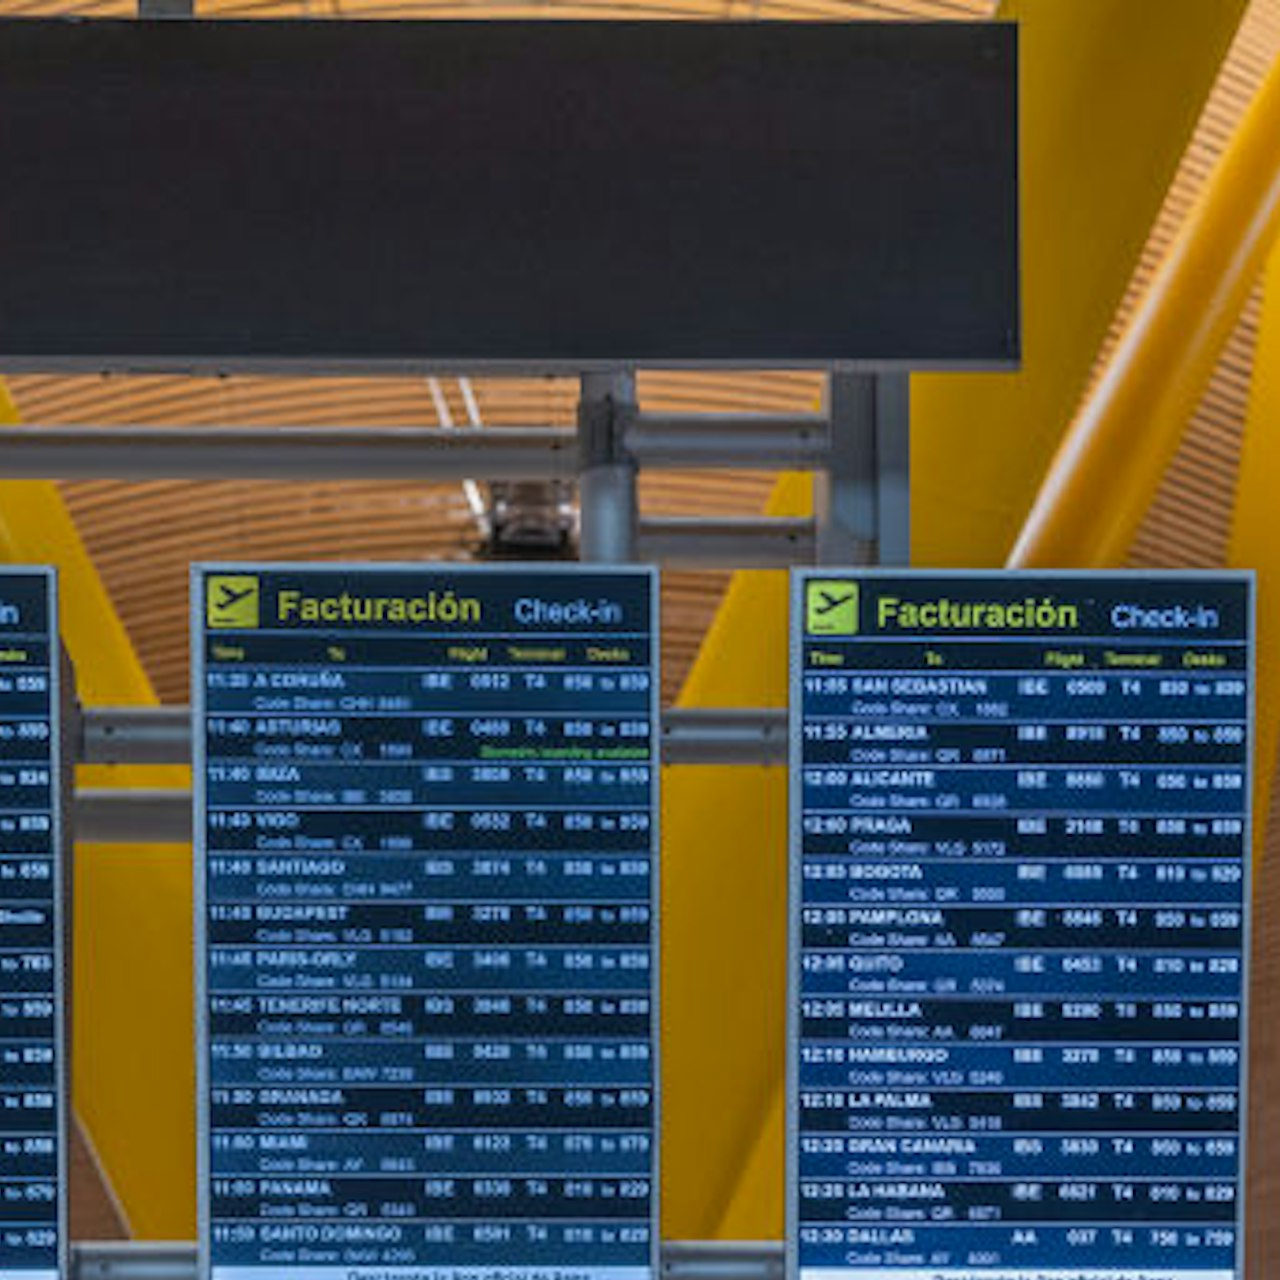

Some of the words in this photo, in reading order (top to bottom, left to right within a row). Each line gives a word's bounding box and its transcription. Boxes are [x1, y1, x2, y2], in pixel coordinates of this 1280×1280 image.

[278, 592, 481, 622] Facturación
[515, 599, 622, 623] Check-in
[877, 598, 1078, 628] Facturación
[1111, 605, 1218, 629] Check-in
